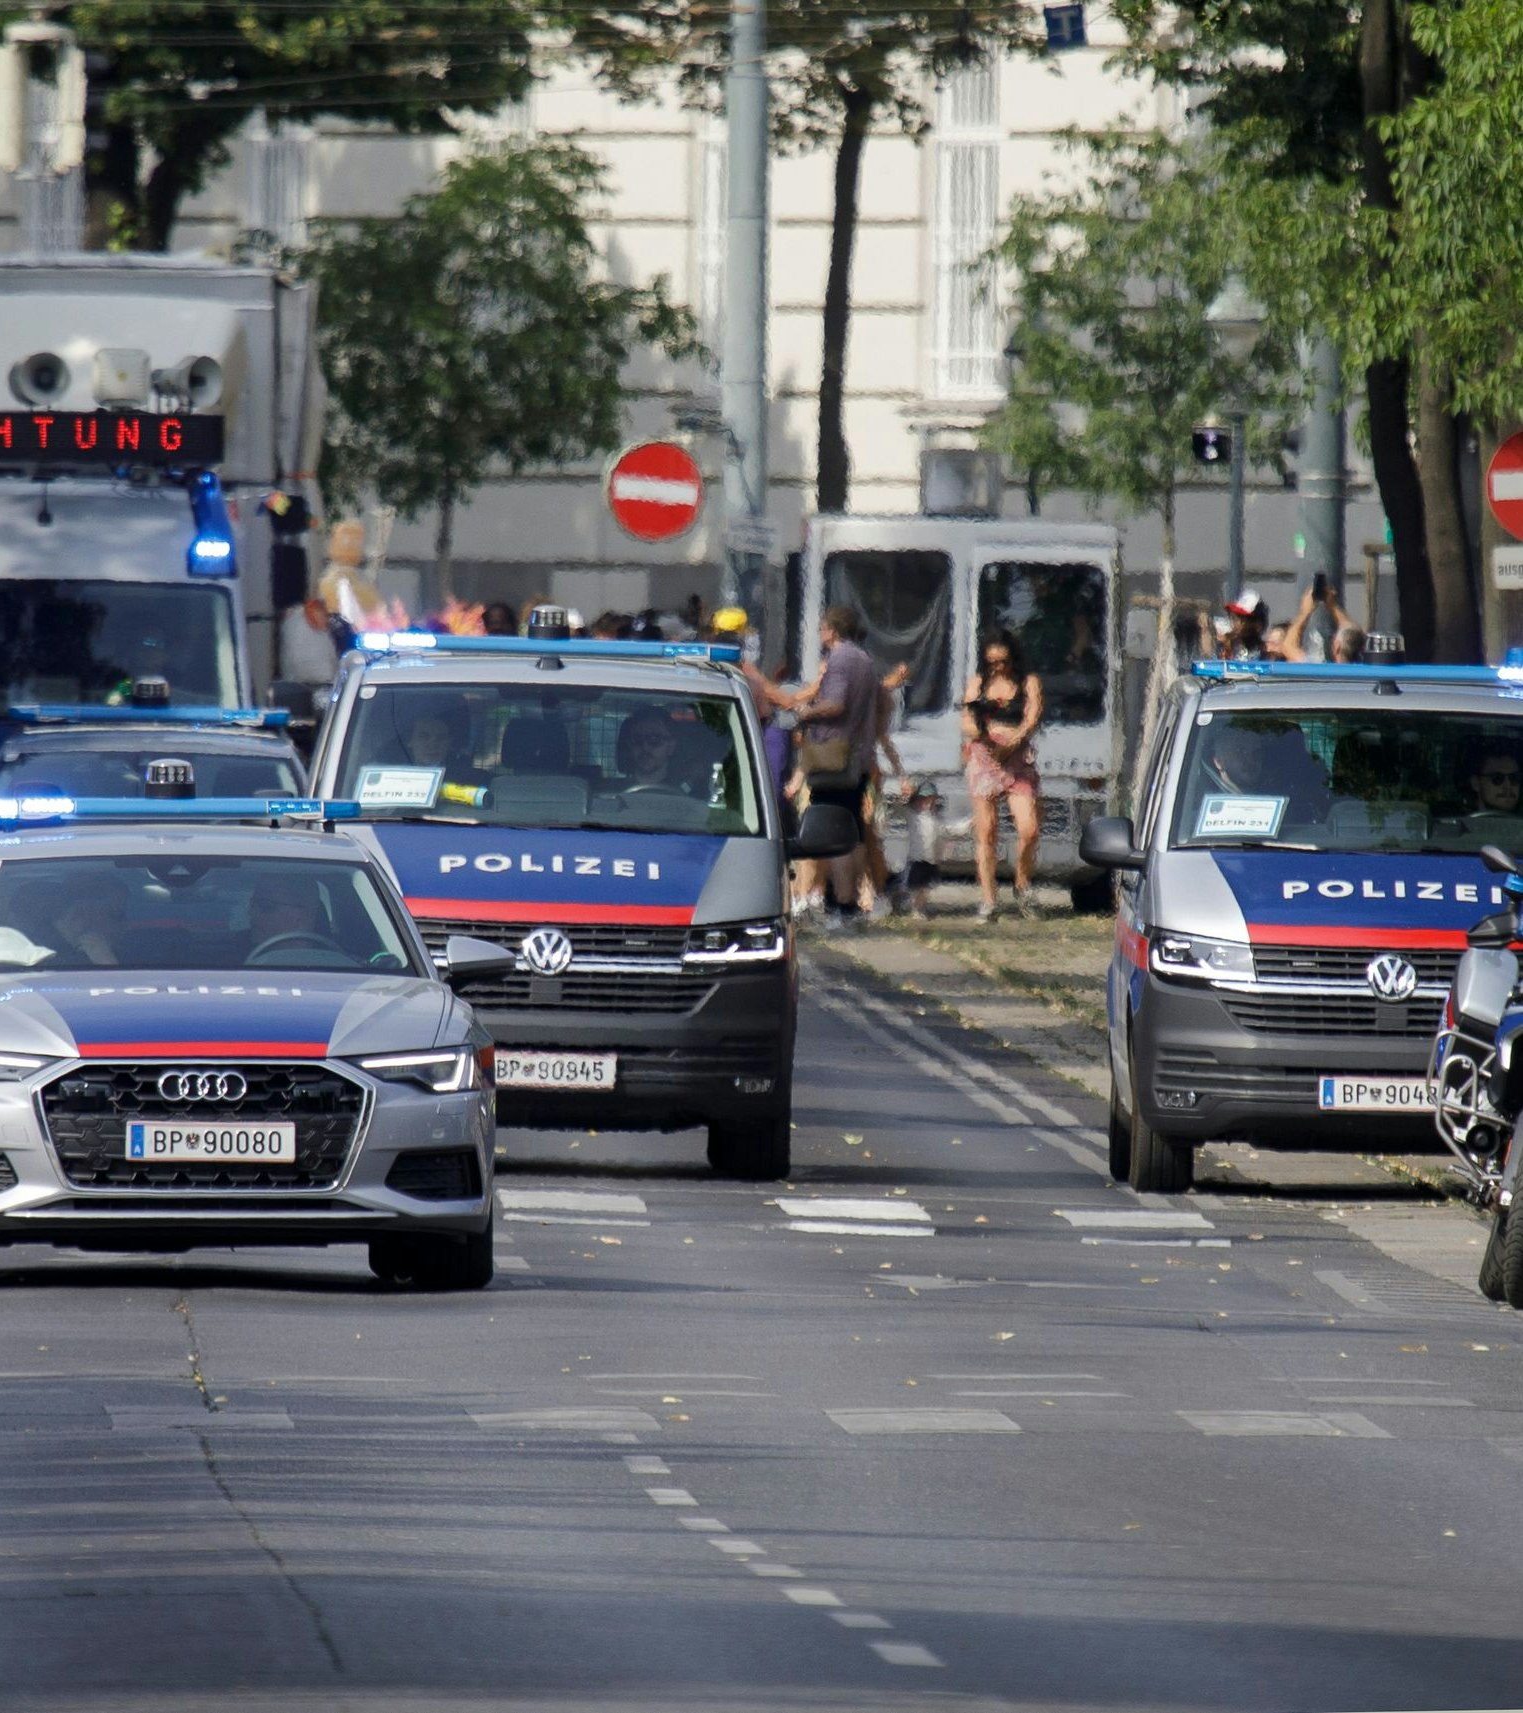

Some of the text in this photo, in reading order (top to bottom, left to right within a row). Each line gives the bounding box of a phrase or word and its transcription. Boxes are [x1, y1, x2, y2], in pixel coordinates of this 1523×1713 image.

[1205, 819, 1246, 827] DELFIN
[439, 853, 660, 880] POLIZEI
[1282, 879, 1502, 904] POLIZEI
[90, 986, 302, 996] POLIZEI
[496, 1059, 604, 1081] BP 90945
[1343, 1084, 1367, 1104] BP
[154, 1130, 282, 1154] BP 90080
